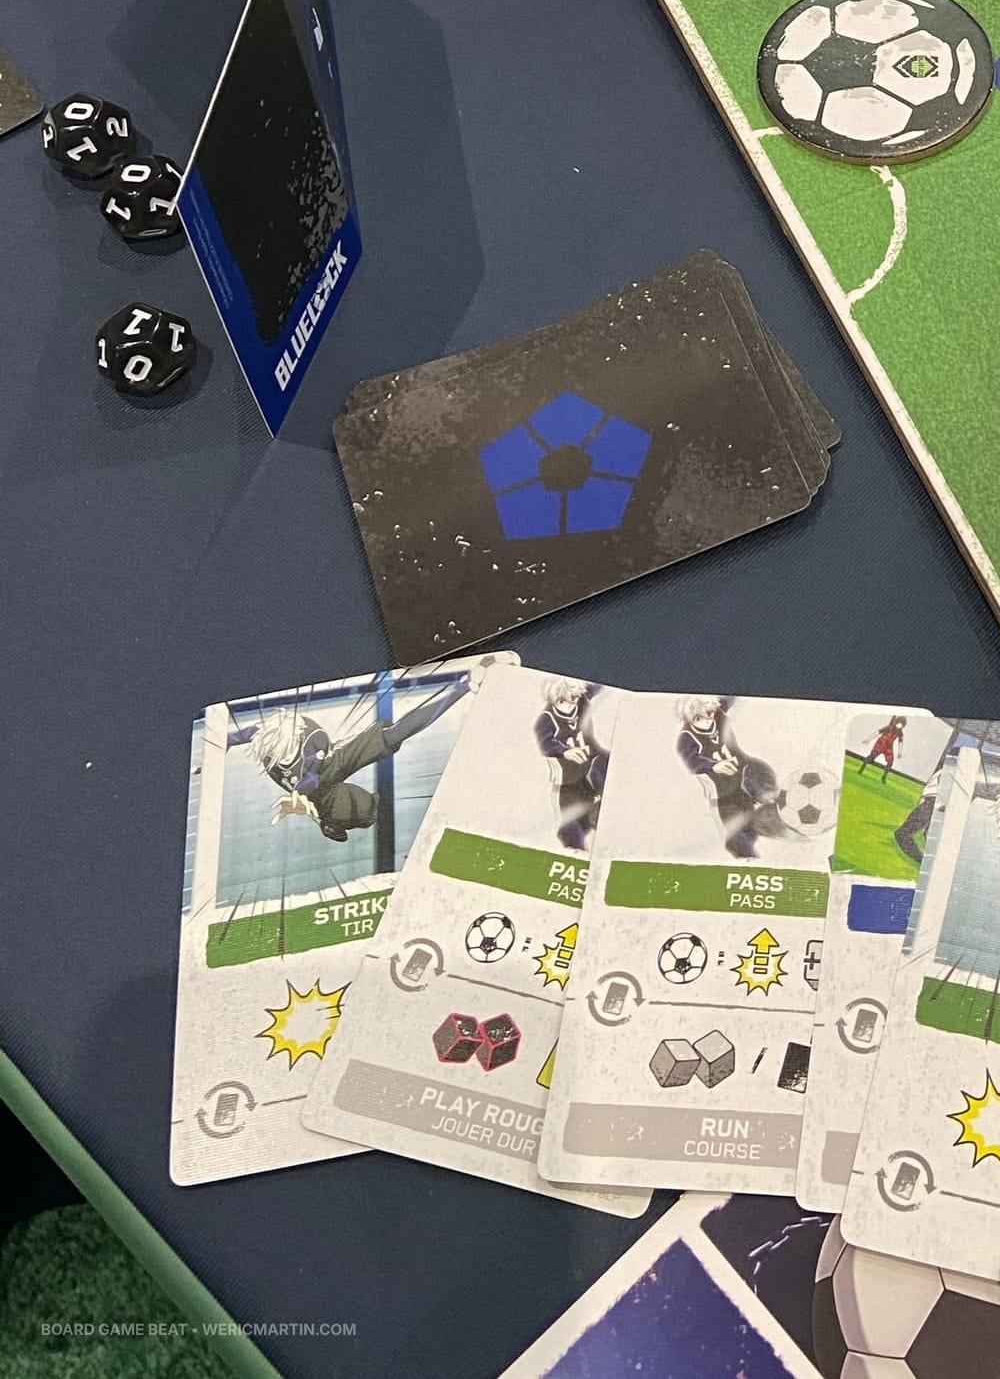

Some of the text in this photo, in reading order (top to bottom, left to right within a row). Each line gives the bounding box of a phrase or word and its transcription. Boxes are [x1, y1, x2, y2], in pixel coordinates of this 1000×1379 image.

[64, 102, 94, 120] 0
[106, 117, 129, 137] 2
[66, 136, 98, 161] 1
[121, 164, 151, 183] 0
[106, 197, 131, 221] 1
[123, 308, 153, 335] 1
[274, 239, 348, 392] BLUELOCK
[168, 322, 185, 352] 1
[123, 354, 153, 381] 0
[548, 860, 590, 885] PAS
[726, 873, 784, 892] PASS
[547, 882, 584, 903] PAS
[730, 892, 776, 909] PASS
[313, 894, 391, 926] STRIK
[341, 918, 374, 937] TIR
[420, 1086, 545, 1135] PLAY ROUG
[431, 1115, 537, 1156] JOUER DUR
[700, 1117, 750, 1139] RUN
[683, 1140, 761, 1160] COURSE
